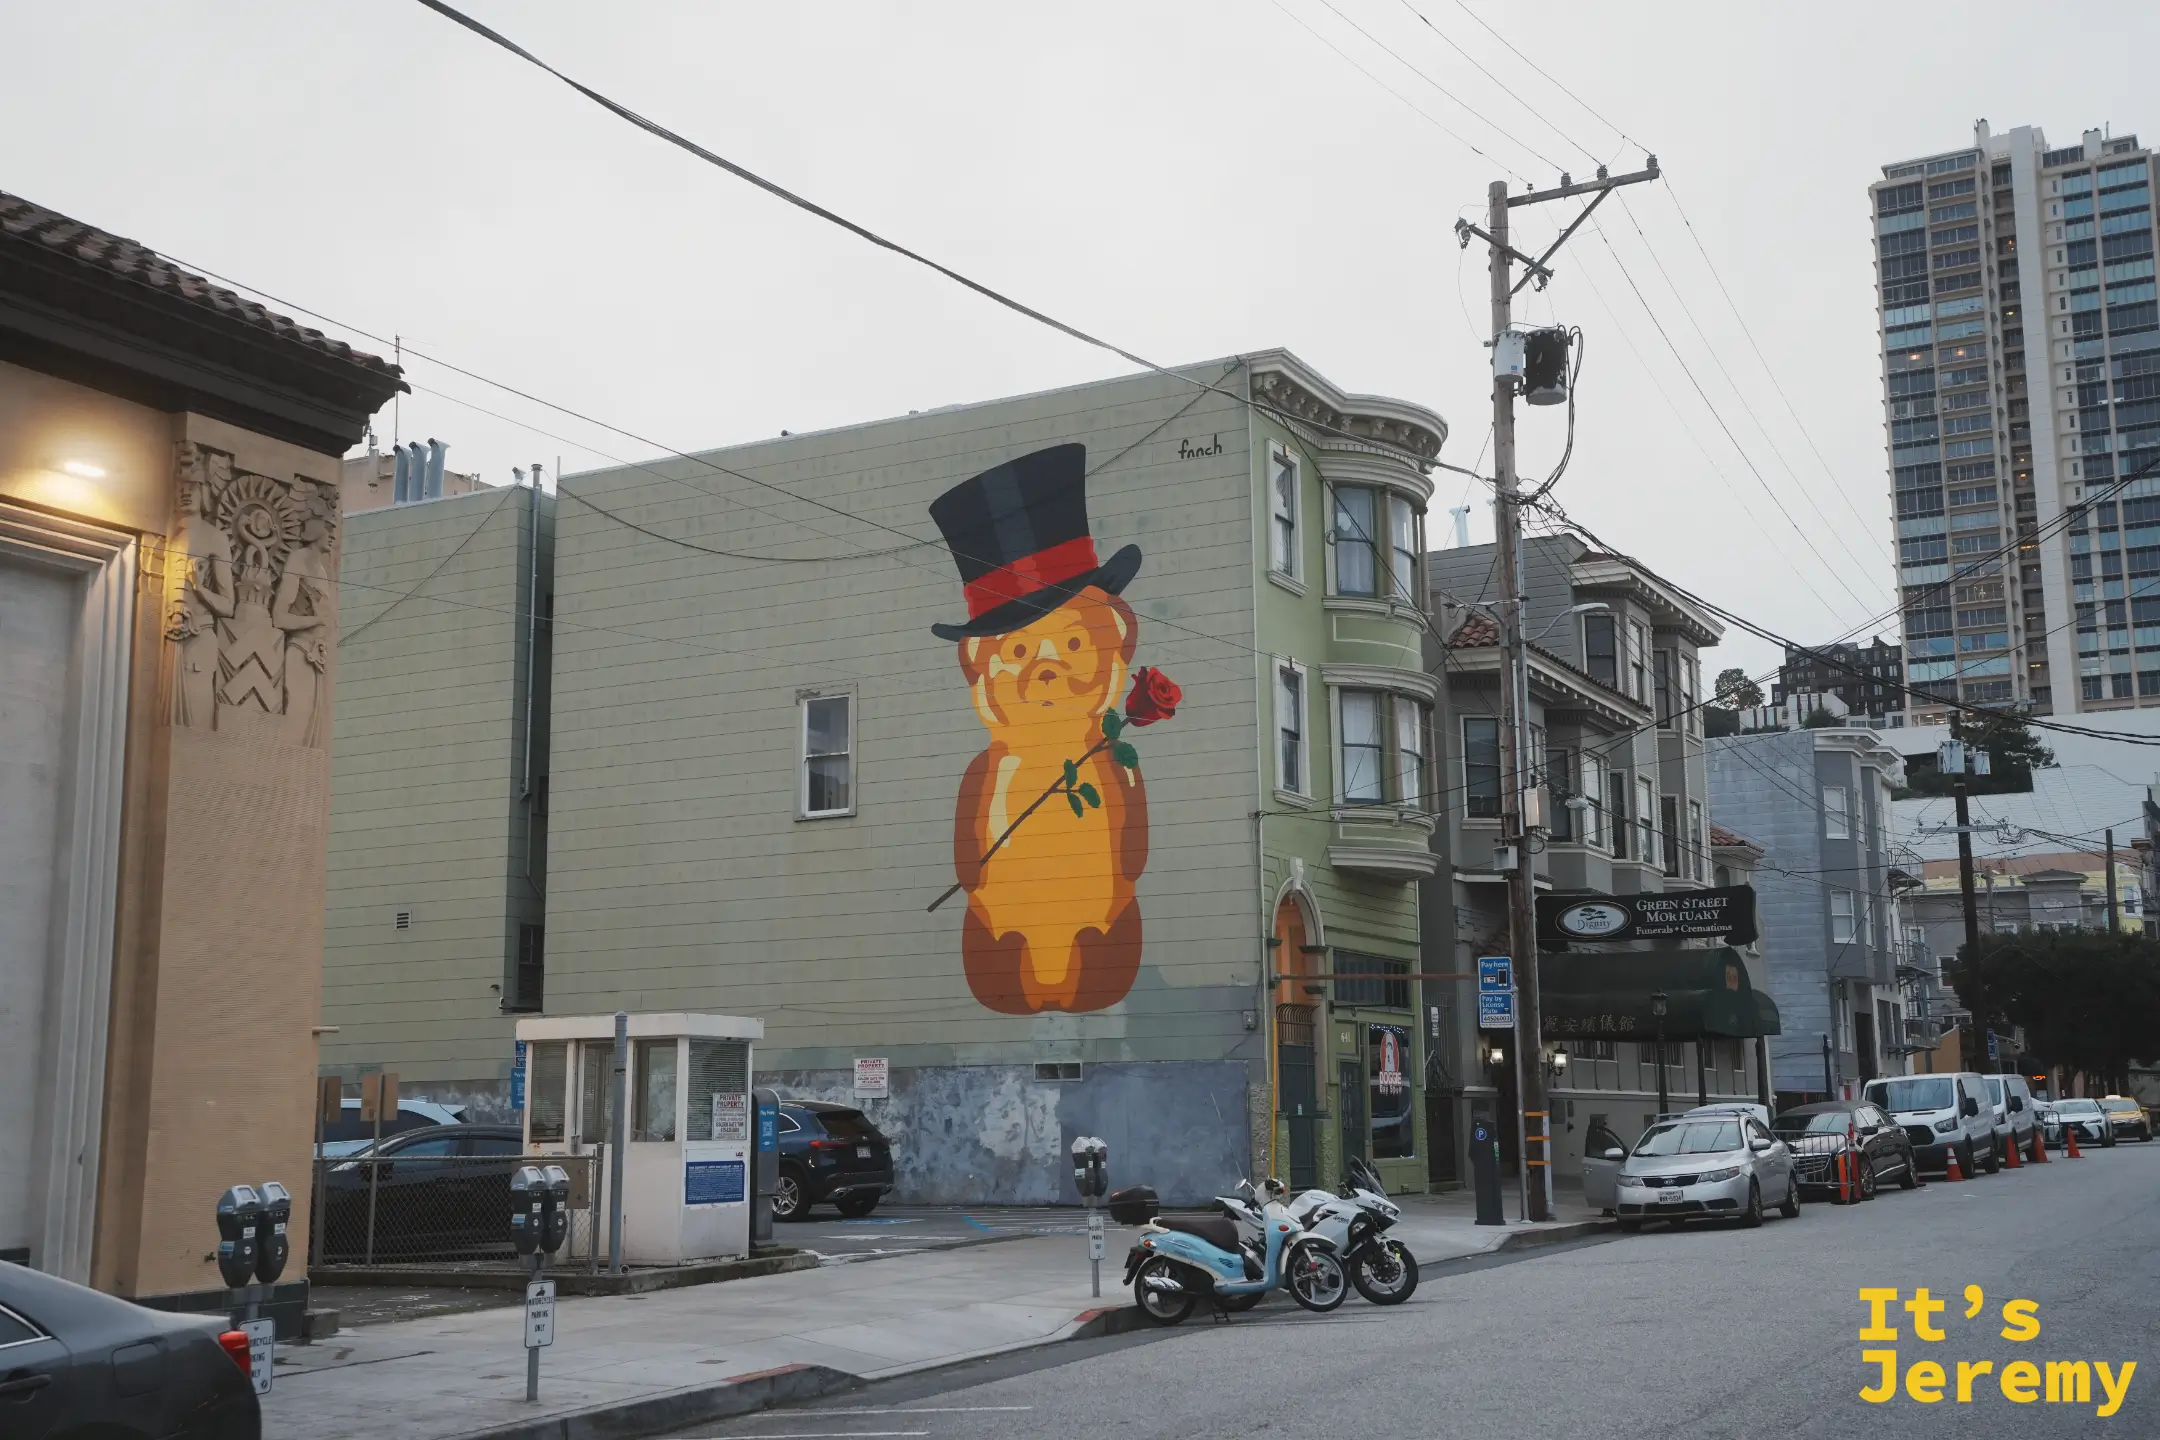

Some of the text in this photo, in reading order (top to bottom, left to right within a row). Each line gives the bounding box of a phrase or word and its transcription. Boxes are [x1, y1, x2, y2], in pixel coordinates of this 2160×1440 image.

[1636, 897, 1728, 911] GREEN STREET
[1646, 910, 1720, 922] MORTUARY
[1577, 919, 1612, 931] Dignity
[1636, 923, 1733, 935] Funerals Cremations
[1481, 961, 1493, 969] Pay
[1482, 995, 1503, 1003] Pay by
[1379, 1071, 1402, 1085] DOGGIE
[716, 1100, 745, 1108] PROPERTY
[535, 1324, 545, 1332] ONLY
